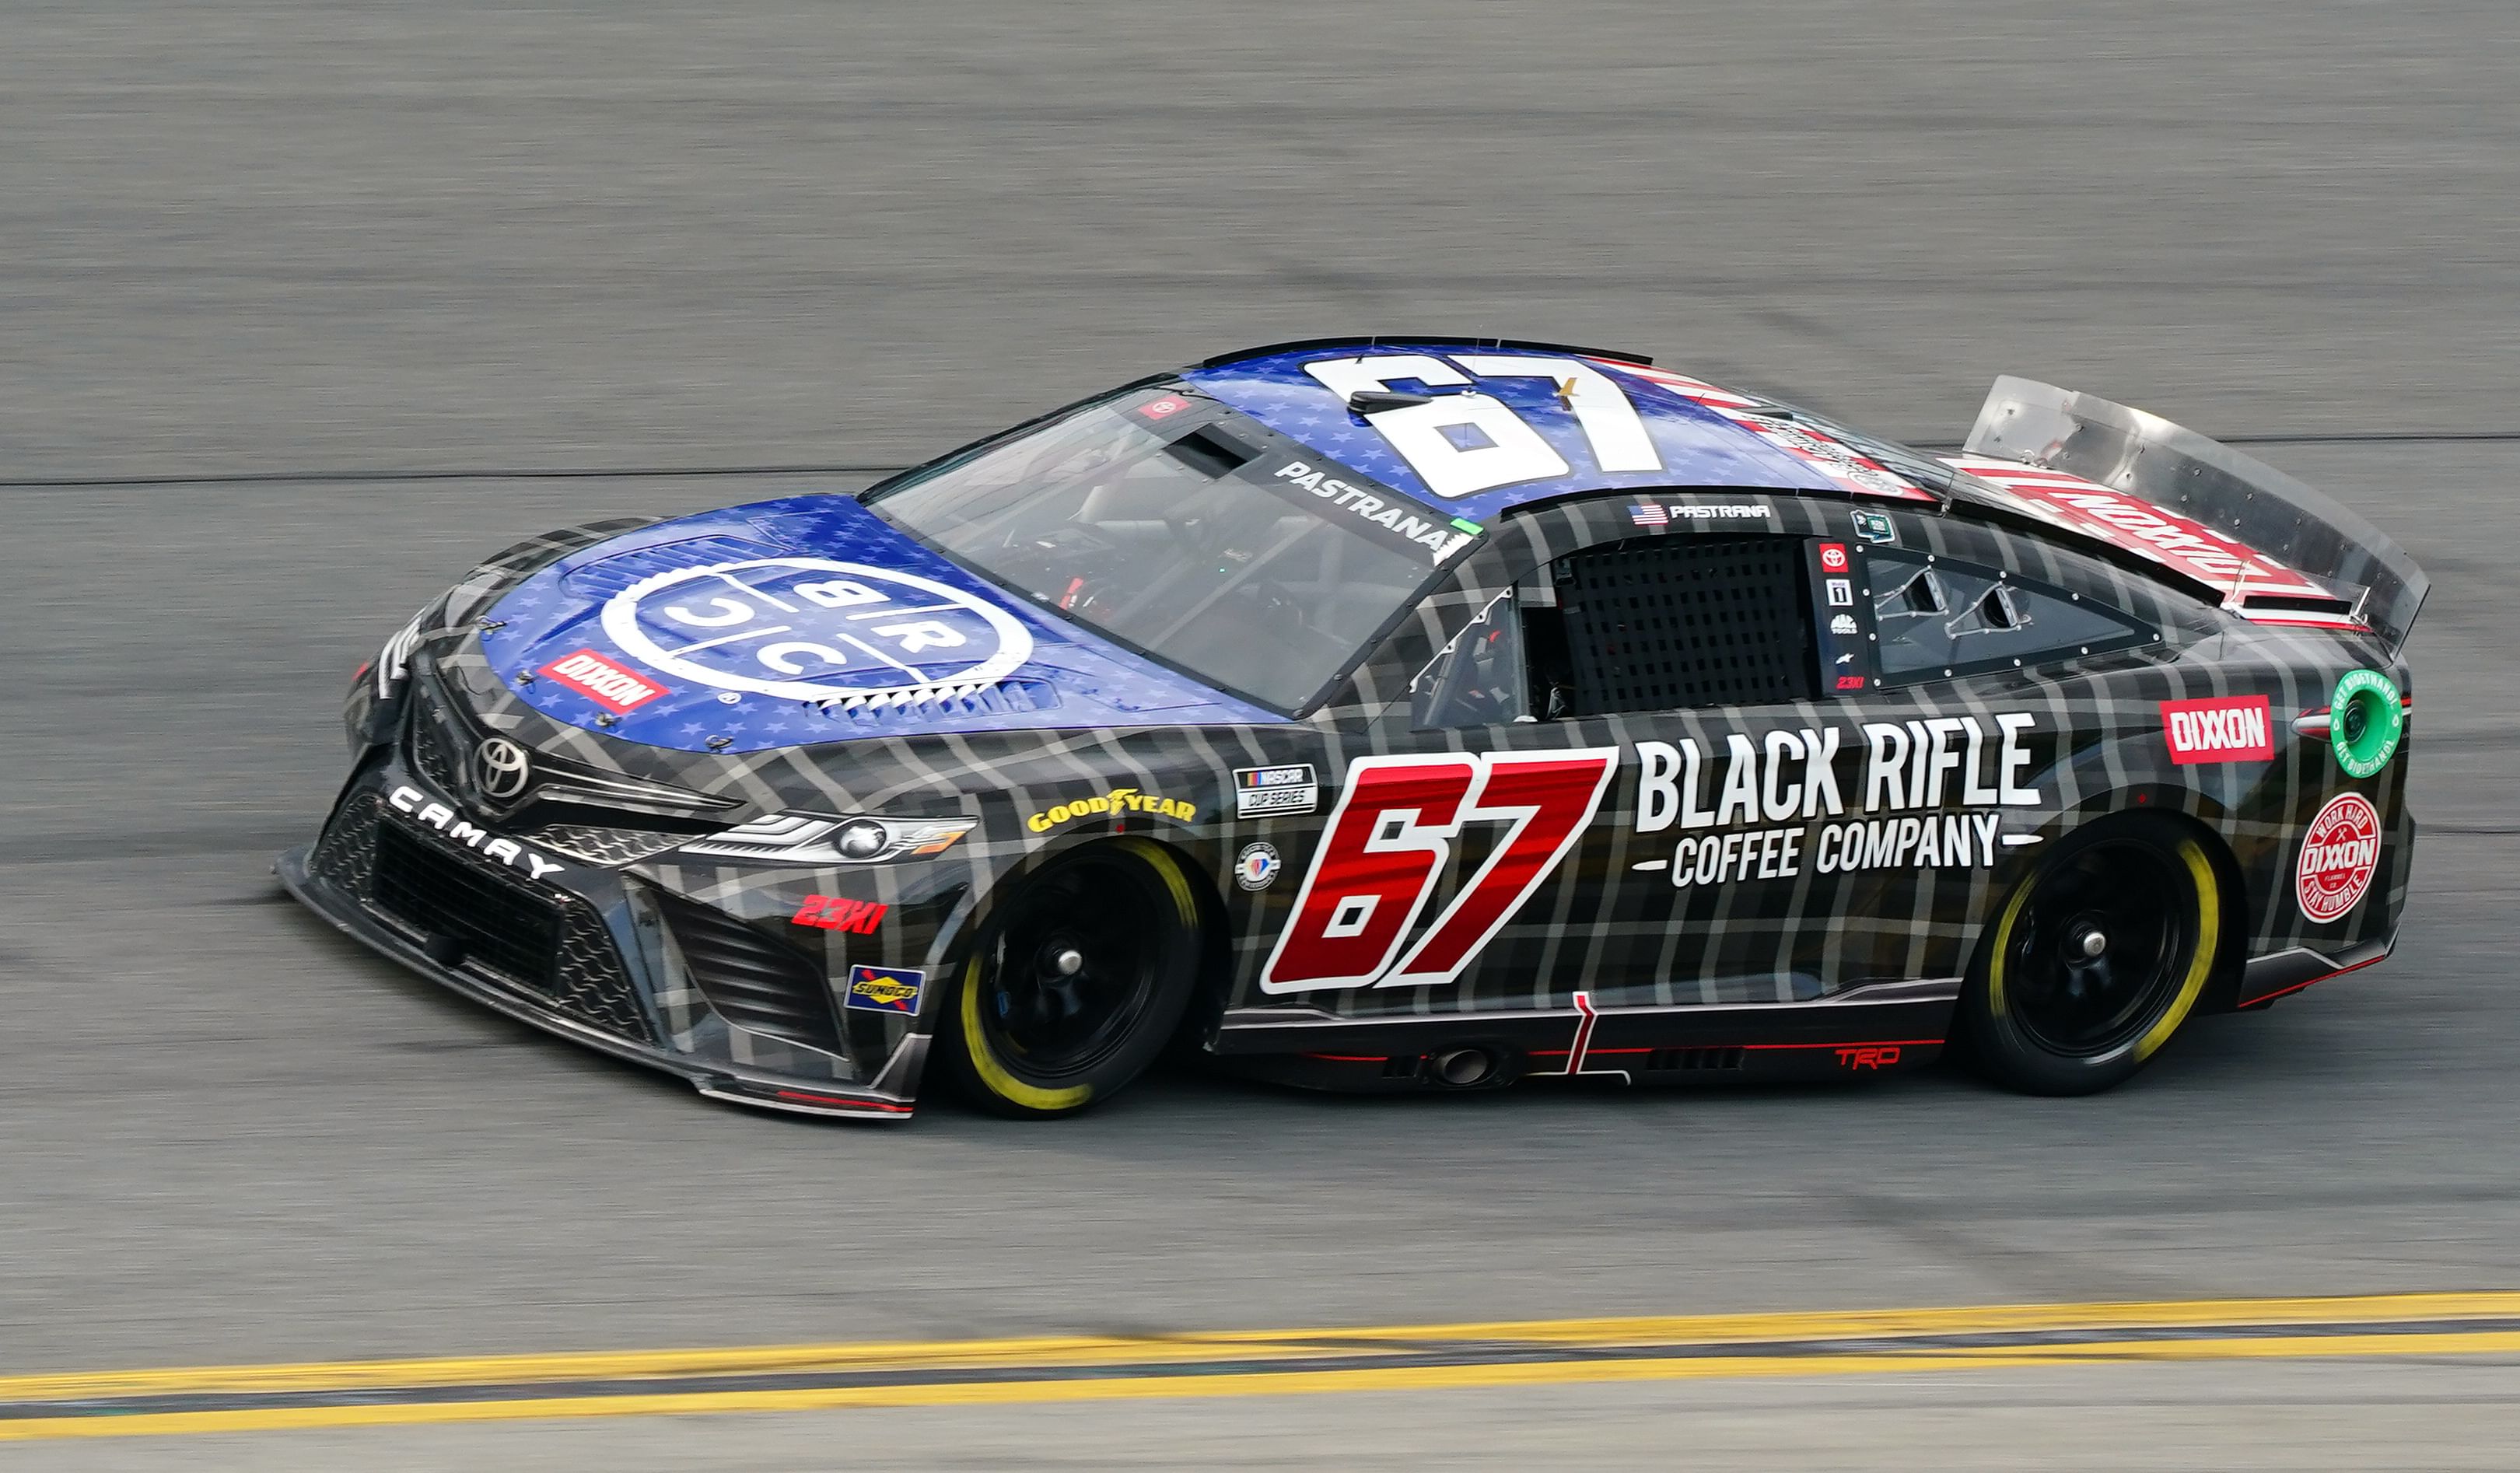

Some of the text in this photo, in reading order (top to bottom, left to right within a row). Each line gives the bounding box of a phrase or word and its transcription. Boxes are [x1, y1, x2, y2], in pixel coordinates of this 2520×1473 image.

[1302, 354, 1664, 499] 67
[1274, 460, 1449, 552] PASTRANA
[1668, 505, 1771, 519] PASTRANA
[2046, 490, 2274, 579] DIXXON
[551, 654, 656, 707] DIXXON
[1836, 676, 1865, 690] 23XI
[2334, 672, 2398, 711] GET BIOETHANOL
[2169, 707, 2266, 752] DIXXON
[2336, 741, 2348, 763] GET
[1262, 768, 1304, 785] NASCAR
[1635, 712, 2043, 833] BLACK RIFLE
[1249, 789, 1305, 807] CUP SERIES
[2315, 804, 2369, 840] WORK HARD
[1671, 813, 2001, 888] COFFEE COMPANY
[2301, 838, 2375, 875] DIXXON
[1259, 746, 1620, 996] 67
[2304, 875, 2364, 911] STAY HUMBLE
[791, 894, 890, 935] 23XI
[1835, 1047, 1901, 1070] TRD
